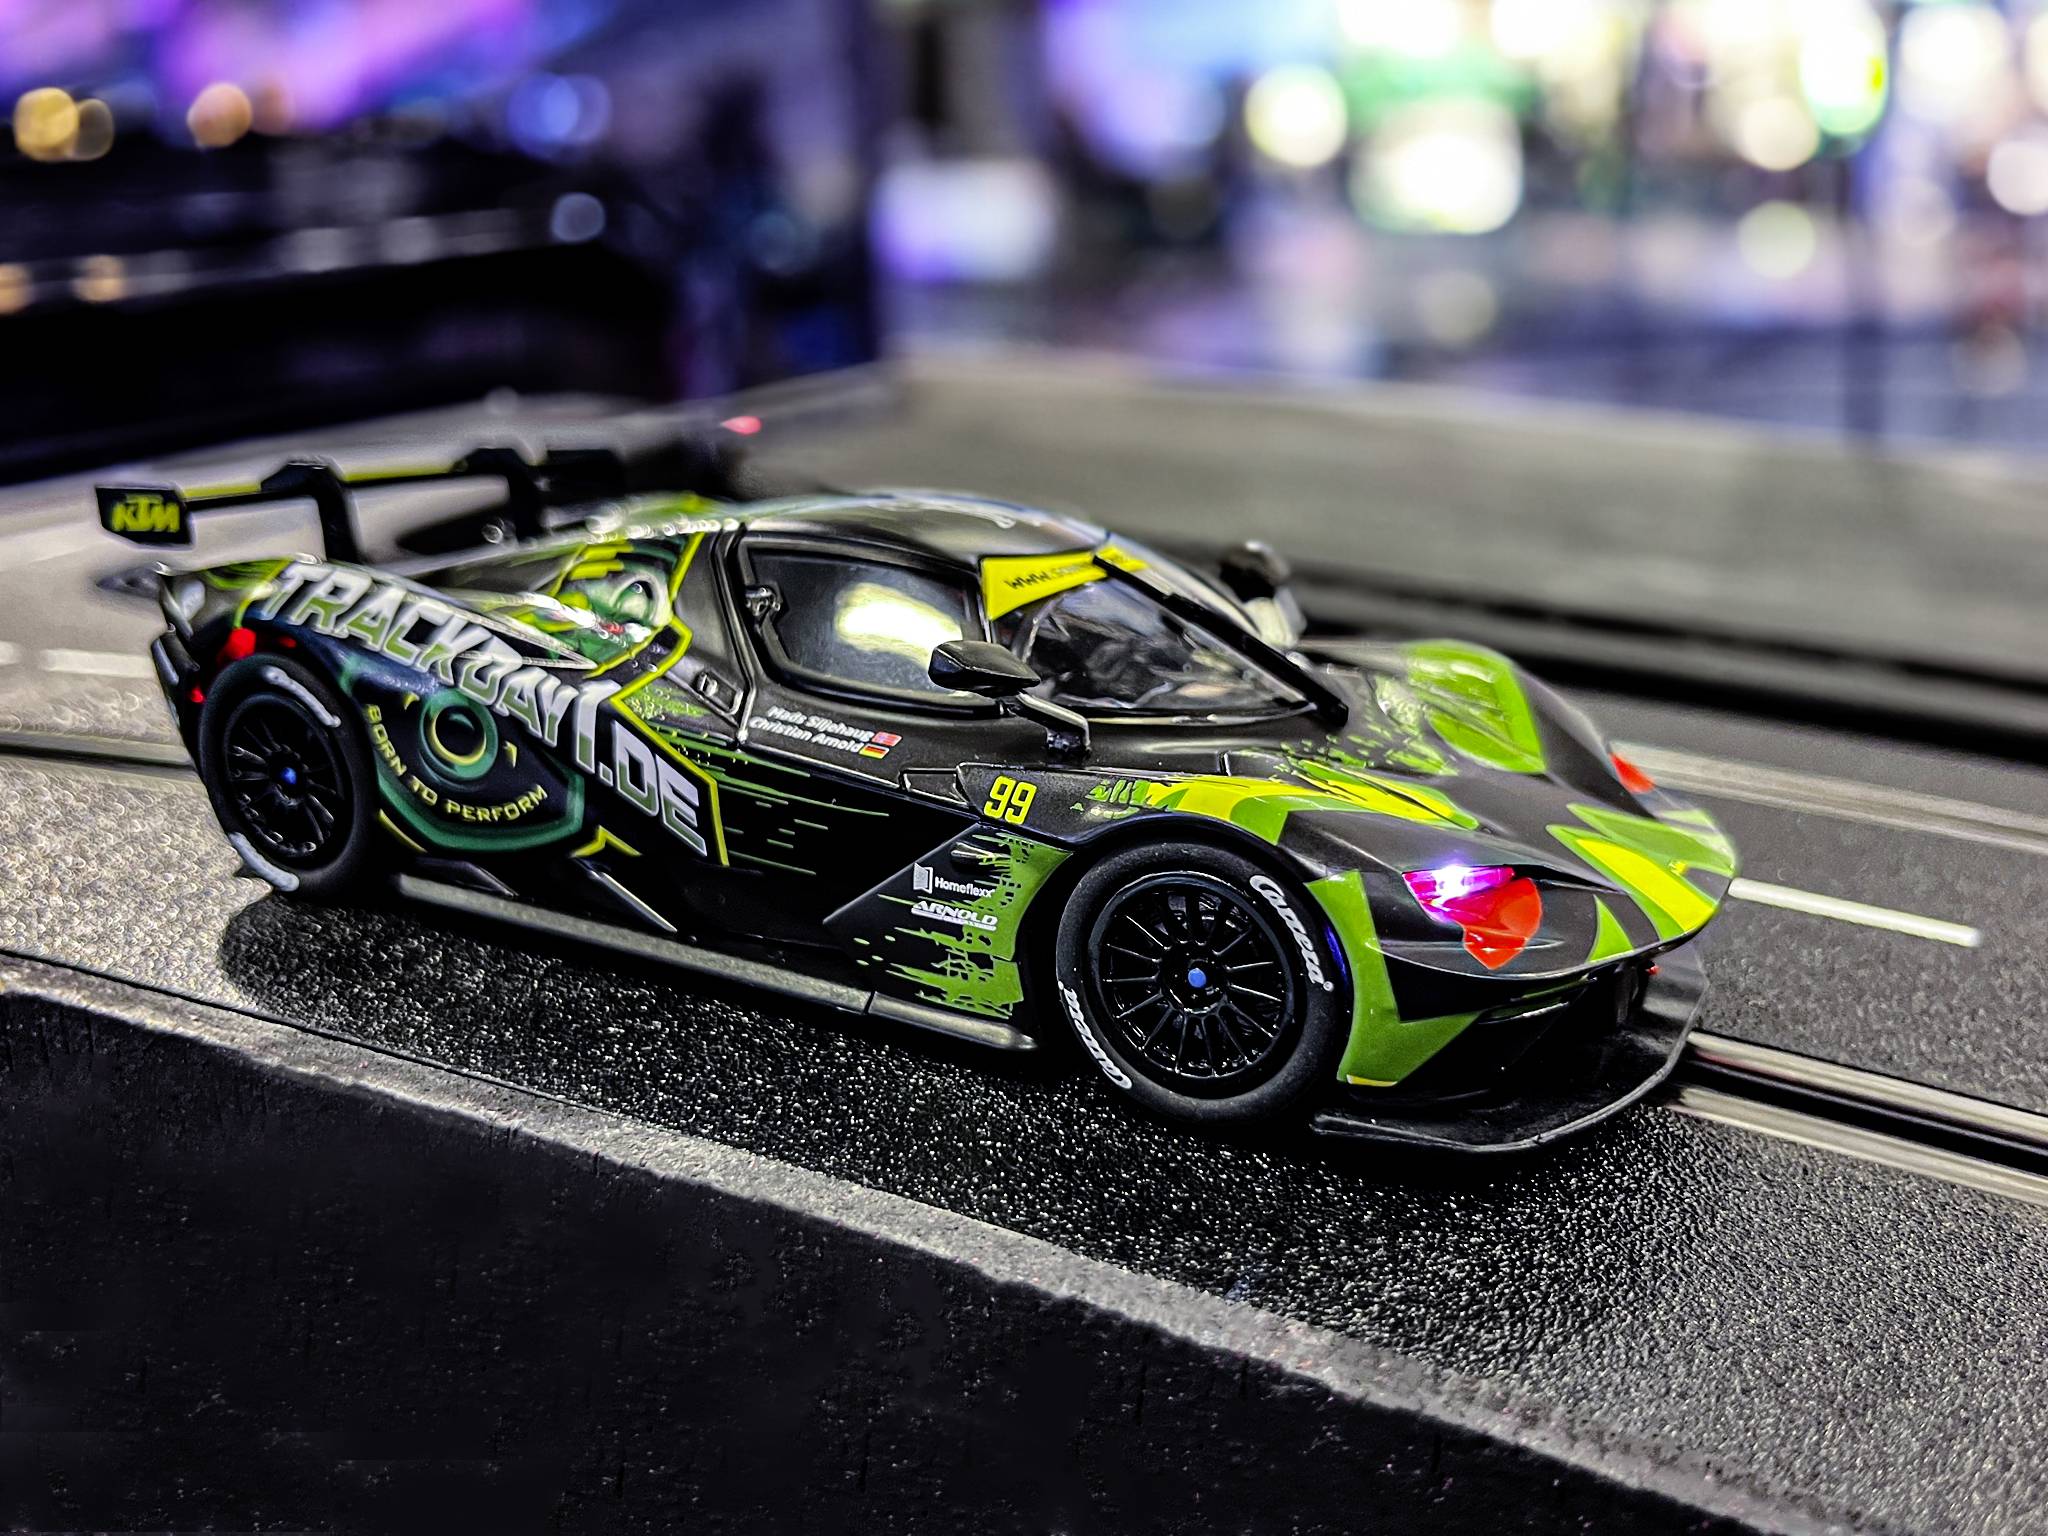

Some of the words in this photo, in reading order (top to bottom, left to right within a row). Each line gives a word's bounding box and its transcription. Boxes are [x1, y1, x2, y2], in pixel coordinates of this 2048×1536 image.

[111, 493, 180, 532] KTM
[749, 716, 813, 741] Christian
[811, 732, 865, 753] Arnold
[767, 706, 808, 725] Mads
[367, 703, 407, 776] BORN
[408, 775, 438, 806] TO
[445, 783, 548, 822] PERFORM
[983, 775, 1038, 825] 99
[934, 876, 996, 898] Homeflexx
[912, 900, 998, 926] ARNOLD
[1249, 875, 1326, 985] Carrera
